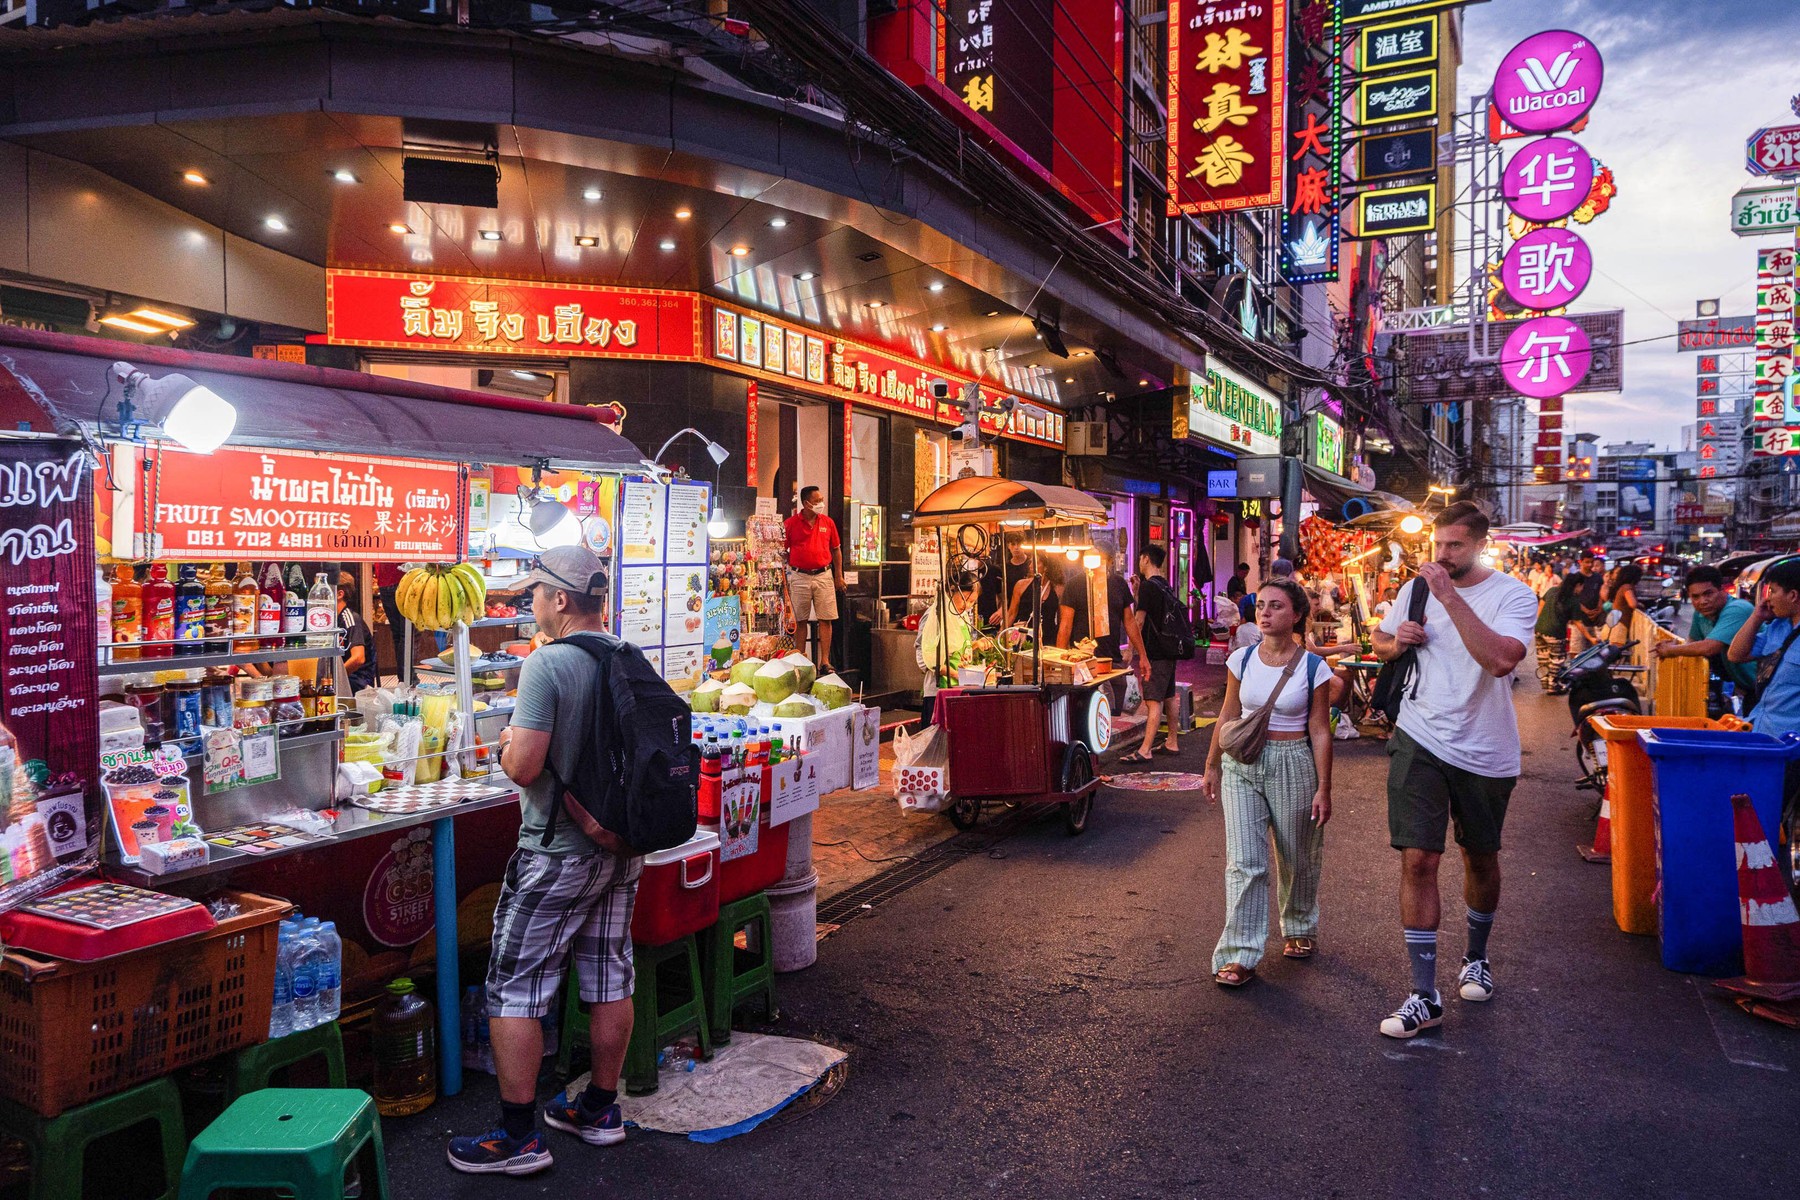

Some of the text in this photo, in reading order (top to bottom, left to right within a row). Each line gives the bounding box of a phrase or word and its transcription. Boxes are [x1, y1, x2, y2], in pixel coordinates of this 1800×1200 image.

[1375, 30, 1424, 59] 温室
[1186, 28, 1263, 187] 林真香
[400, 280, 638, 347] ลิ้ม จิง เฮียง
[619, 297, 680, 309] 360,362,364
[250, 455, 394, 507] น้ำผลไม้ปั่น
[1209, 479, 1230, 488] BAR
[156, 503, 351, 530] FRUIT SMOOTHIES
[374, 510, 458, 537] 果汁冰沙
[188, 530, 225, 547] 081
[235, 531, 271, 547] 702
[326, 529, 387, 549] (เจ้าเก่า)
[222, 755, 240, 767] QR
[390, 898, 430, 921] STREET
[396, 913, 424, 926] FOOD
